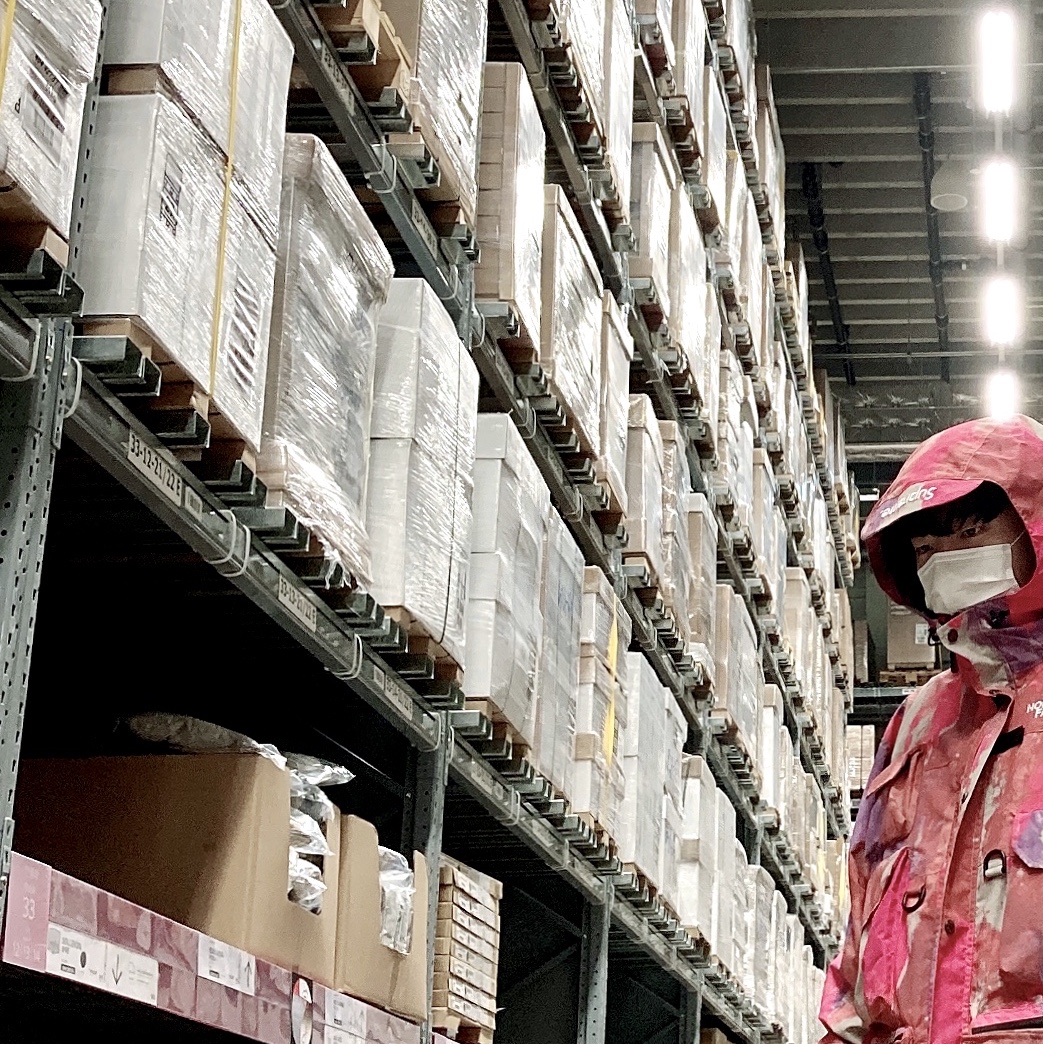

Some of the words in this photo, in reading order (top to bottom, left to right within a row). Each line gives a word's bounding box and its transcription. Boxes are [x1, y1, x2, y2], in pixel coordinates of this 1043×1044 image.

[130, 433, 175, 491] 33-12-21/22
[880, 486, 938, 518] Supreme
[22, 896, 36, 921] 33
